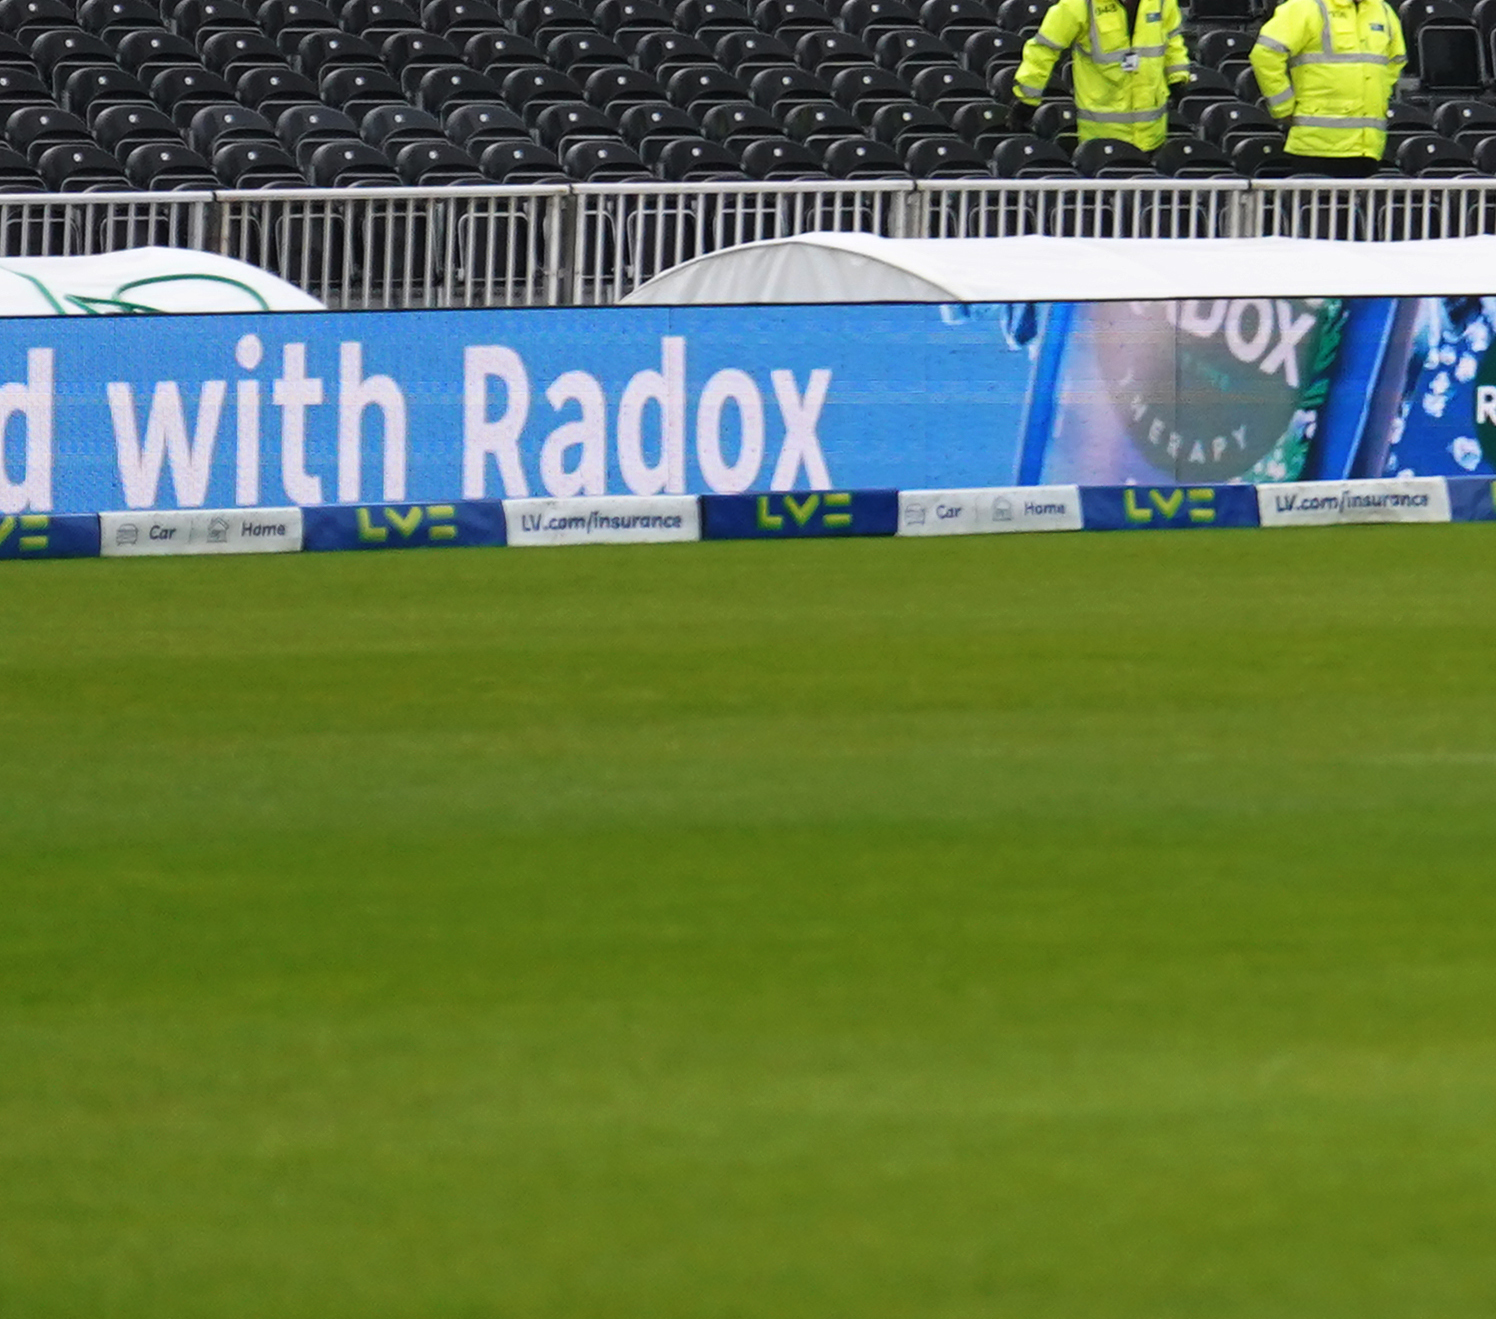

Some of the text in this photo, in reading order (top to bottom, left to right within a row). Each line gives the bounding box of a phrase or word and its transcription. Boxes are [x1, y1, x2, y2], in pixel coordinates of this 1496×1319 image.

[107, 334, 405, 508] with
[462, 336, 832, 500] Radox
[936, 500, 1065, 519] Car Home
[1276, 489, 1428, 512] LV.com/insurance
[149, 521, 286, 541] Car Home
[522, 509, 682, 534] LV.com/insurance
